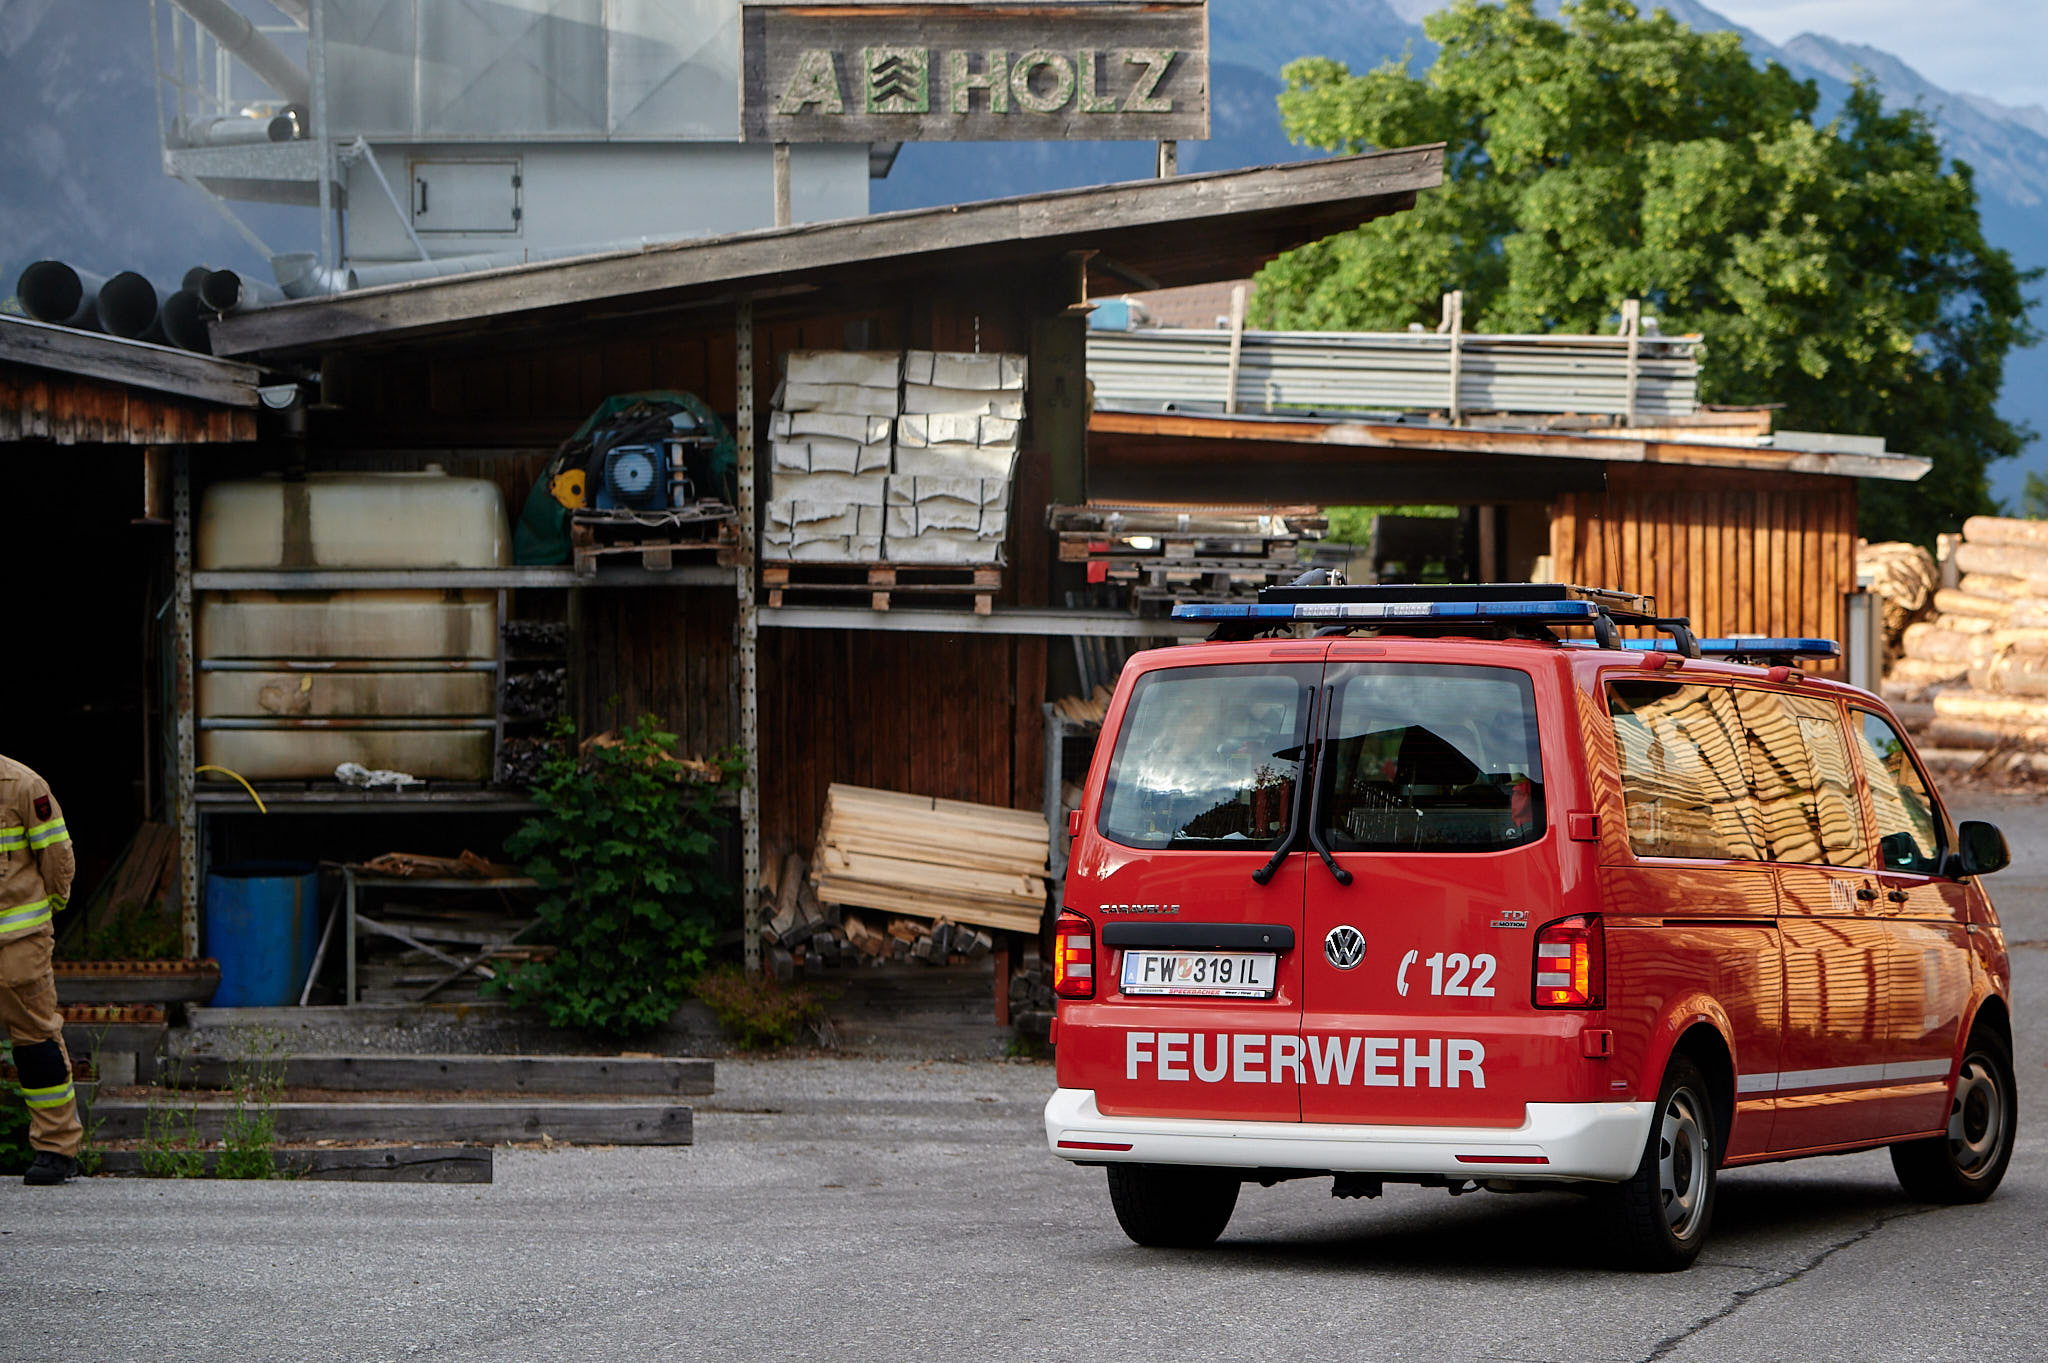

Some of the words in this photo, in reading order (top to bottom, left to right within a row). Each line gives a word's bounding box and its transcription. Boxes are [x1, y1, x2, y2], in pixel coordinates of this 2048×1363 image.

[951, 48, 1177, 115] HOLZ
[1099, 904, 1180, 914] CARAVELLE
[1501, 910, 1529, 920] TDI
[1325, 925, 1366, 970] VW
[1127, 972, 1134, 981] A
[1144, 957, 1177, 982] FW
[1193, 958, 1233, 983] 319
[1239, 959, 1259, 984] IL
[1426, 952, 1497, 997] 122
[1126, 1031, 1486, 1088] FEUERWEHR
